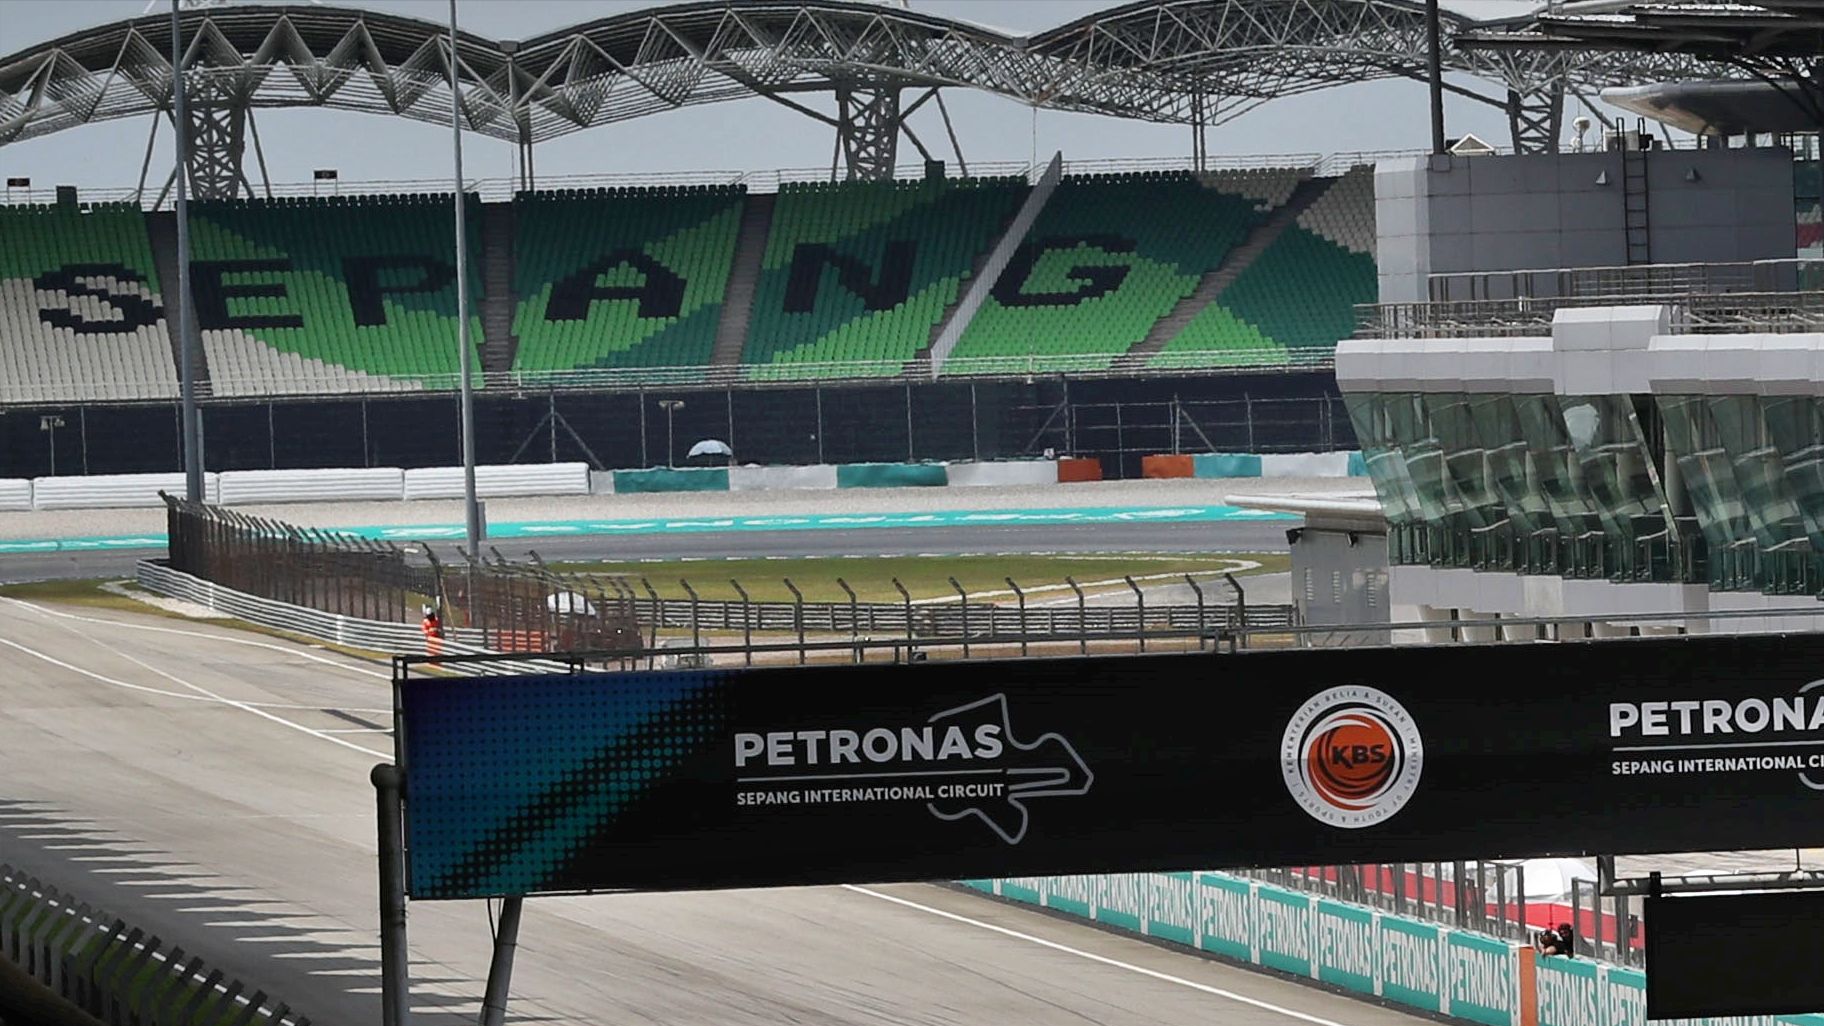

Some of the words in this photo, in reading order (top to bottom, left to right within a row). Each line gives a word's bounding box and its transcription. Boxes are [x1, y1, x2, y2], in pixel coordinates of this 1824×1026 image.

[33, 235, 1137, 333] SEPANG
[734, 724, 1003, 767] PETRONAS
[1331, 744, 1386, 769] KBS
[1612, 761, 1675, 775] SEPANG
[1678, 756, 1806, 773] INTERNATIONAL
[737, 792, 801, 805] SEPANG
[804, 787, 935, 803] INTERNATIONAL
[937, 784, 1005, 798] CIRCUIT
[1149, 873, 1192, 930] PETRONAS
[1202, 884, 1249, 946] PETRONAS
[1260, 897, 1309, 960] PETRONAS
[1319, 912, 1371, 977] PETRONAS
[1383, 928, 1437, 994] PETRONAS
[1450, 944, 1509, 1011] PETRONAS
